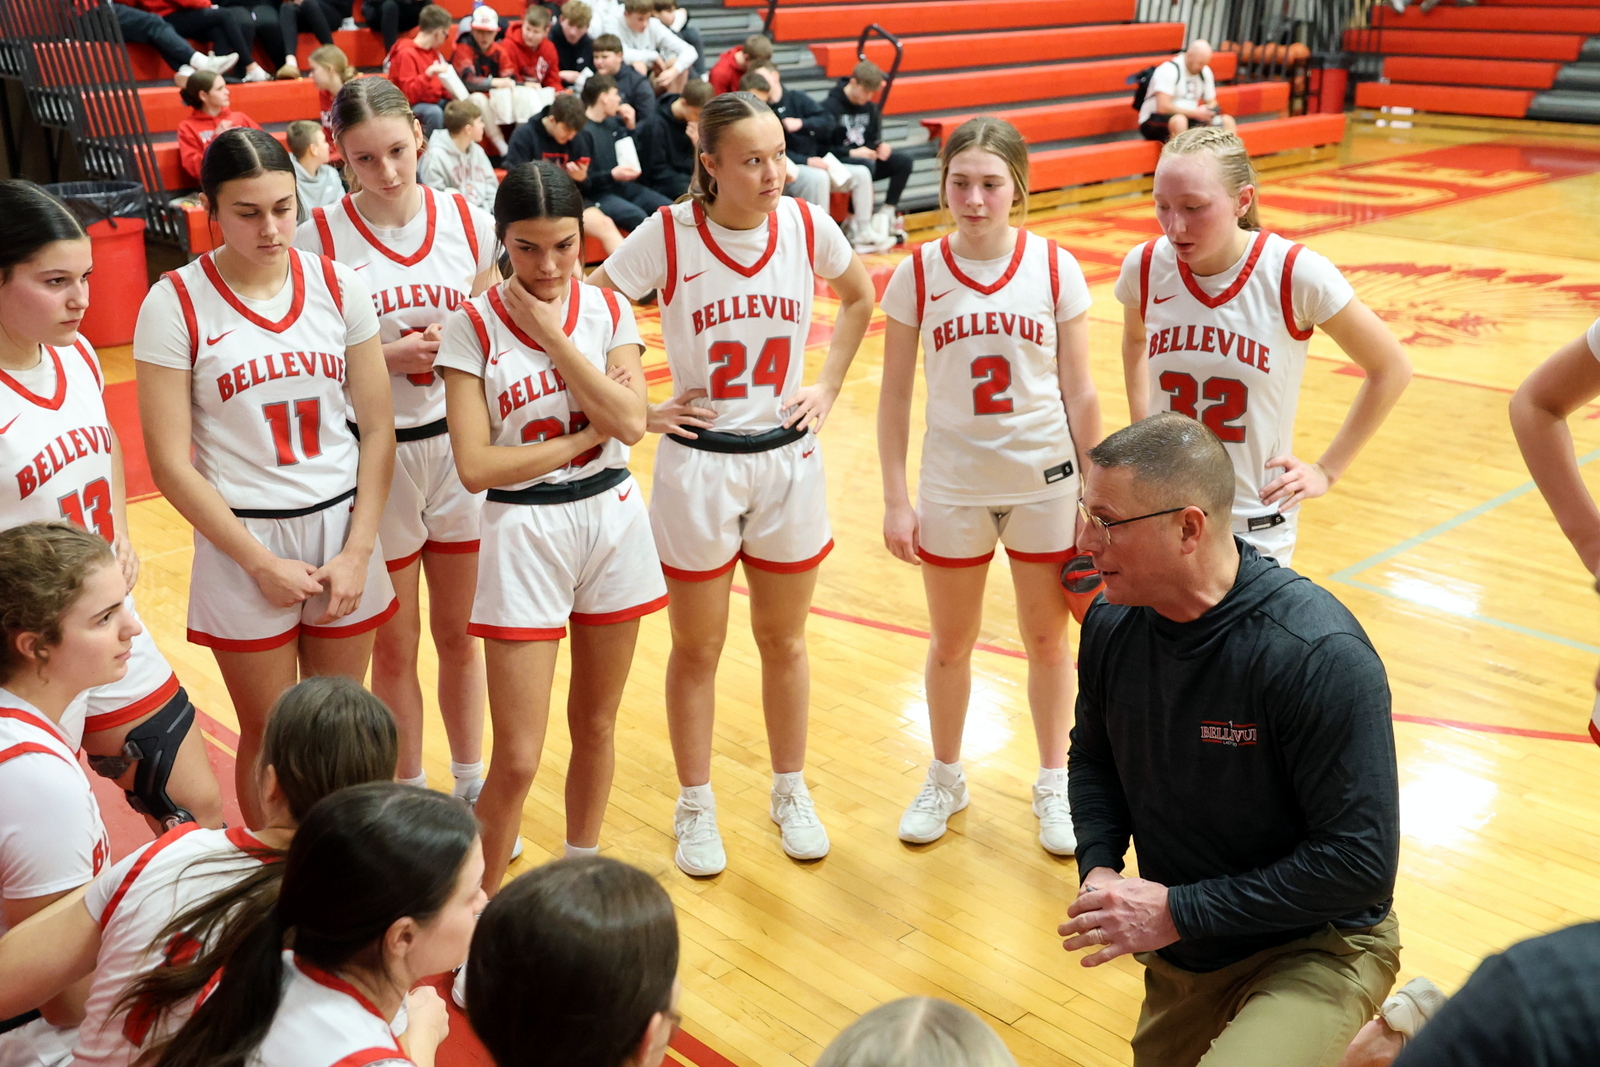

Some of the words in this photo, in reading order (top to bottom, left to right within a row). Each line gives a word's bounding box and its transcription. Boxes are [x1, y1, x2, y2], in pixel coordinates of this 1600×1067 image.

[933, 312, 1044, 352] BELLEVUE
[1148, 325, 1271, 374] BELLEVUE
[708, 336, 791, 401] 24
[970, 355, 1014, 416] 2
[261, 396, 323, 467] 11
[1159, 370, 1248, 443] 32
[57, 475, 115, 544] 13
